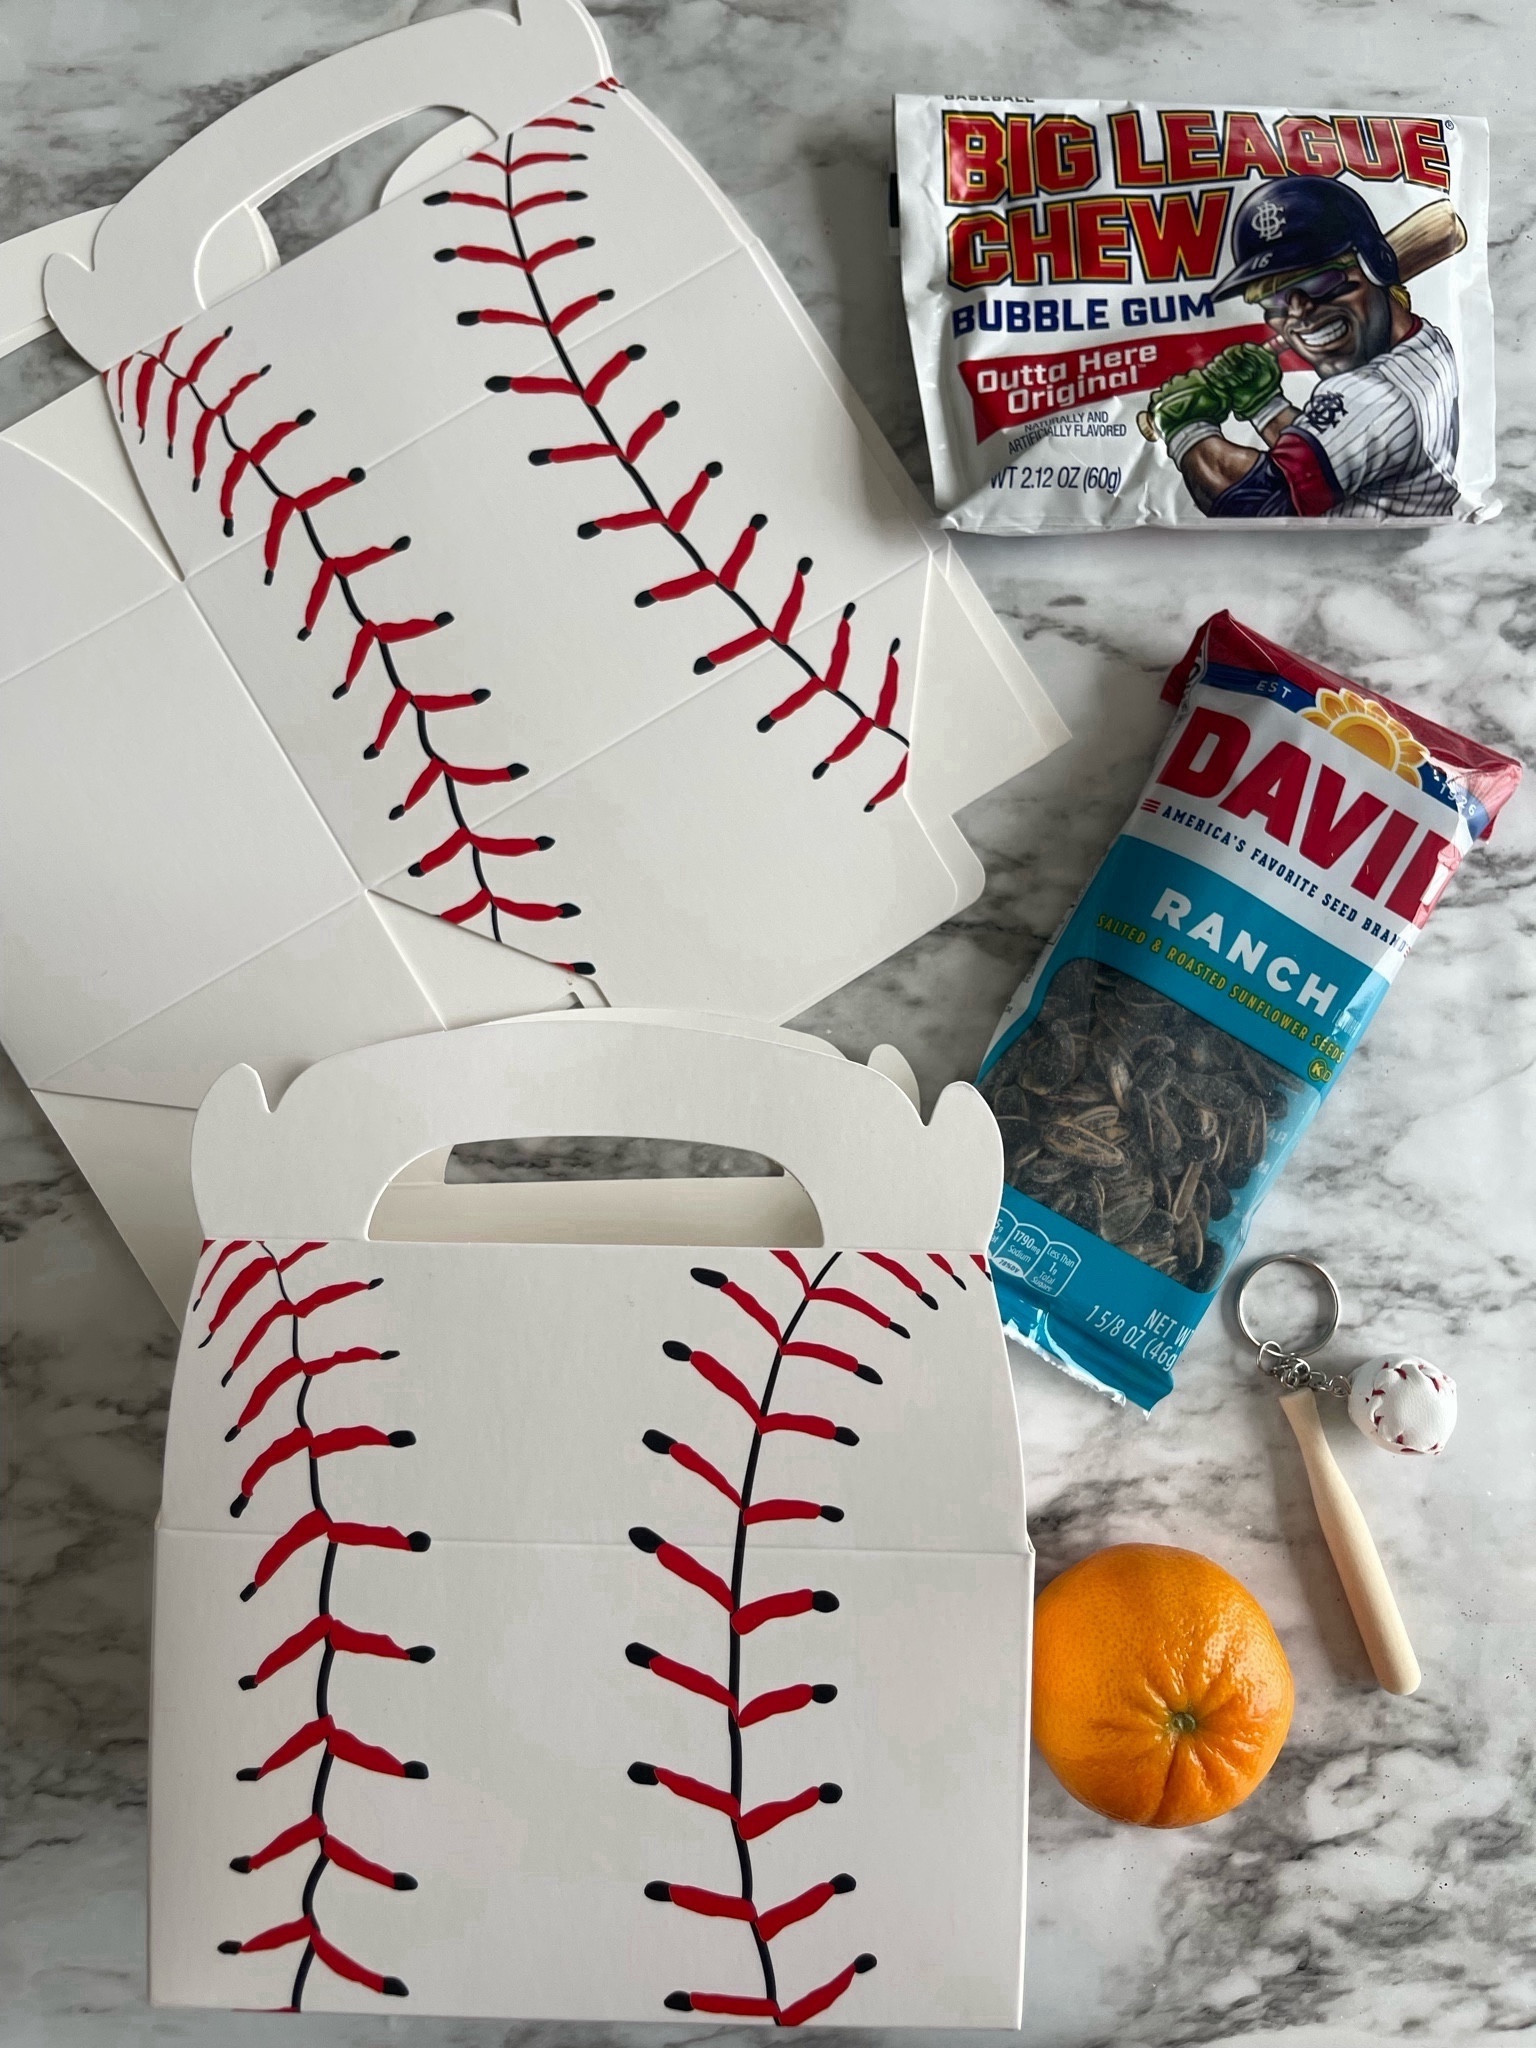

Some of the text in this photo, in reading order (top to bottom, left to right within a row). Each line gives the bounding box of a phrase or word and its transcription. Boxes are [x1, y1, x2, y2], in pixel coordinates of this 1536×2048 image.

[941, 109, 1451, 206] BIG LEAGUE
[947, 188, 1234, 291] CHEW
[1251, 253, 1273, 270] 16
[952, 293, 1216, 339] BUBBLE GUM
[977, 345, 1158, 393] Outta Here
[1008, 365, 1139, 414] Original
[1024, 411, 1109, 432] NATURALLY AND
[1008, 424, 1127, 455] ARTIFICIALLY FLAVORED
[1021, 466, 1054, 489] 2.12
[1057, 466, 1081, 489] OZ
[1083, 466, 1122, 494] (60g)
[1256, 680, 1292, 699] EST
[1440, 783, 1477, 816] 1926
[1162, 805, 1246, 852] AMERICA'S
[1250, 848, 1319, 898] FAVORITE
[1321, 893, 1358, 922] SEED
[1151, 888, 1339, 1016] RANCH
[1096, 914, 1345, 1065] SALTED & ROASTED SUNFLOWER SEEDS
[1008, 1245, 1032, 1263] Sodium
[1013, 1230, 1041, 1256] 1790mg
[1046, 1246, 1076, 1269] Less Than
[1039, 1271, 1056, 1285] Total
[1049, 1261, 1058, 1275] 1g
[1086, 1305, 1100, 1321] 1
[1094, 1311, 1125, 1337] 5/8
[1122, 1325, 1147, 1349] OZ
[1144, 1309, 1178, 1338] NET
